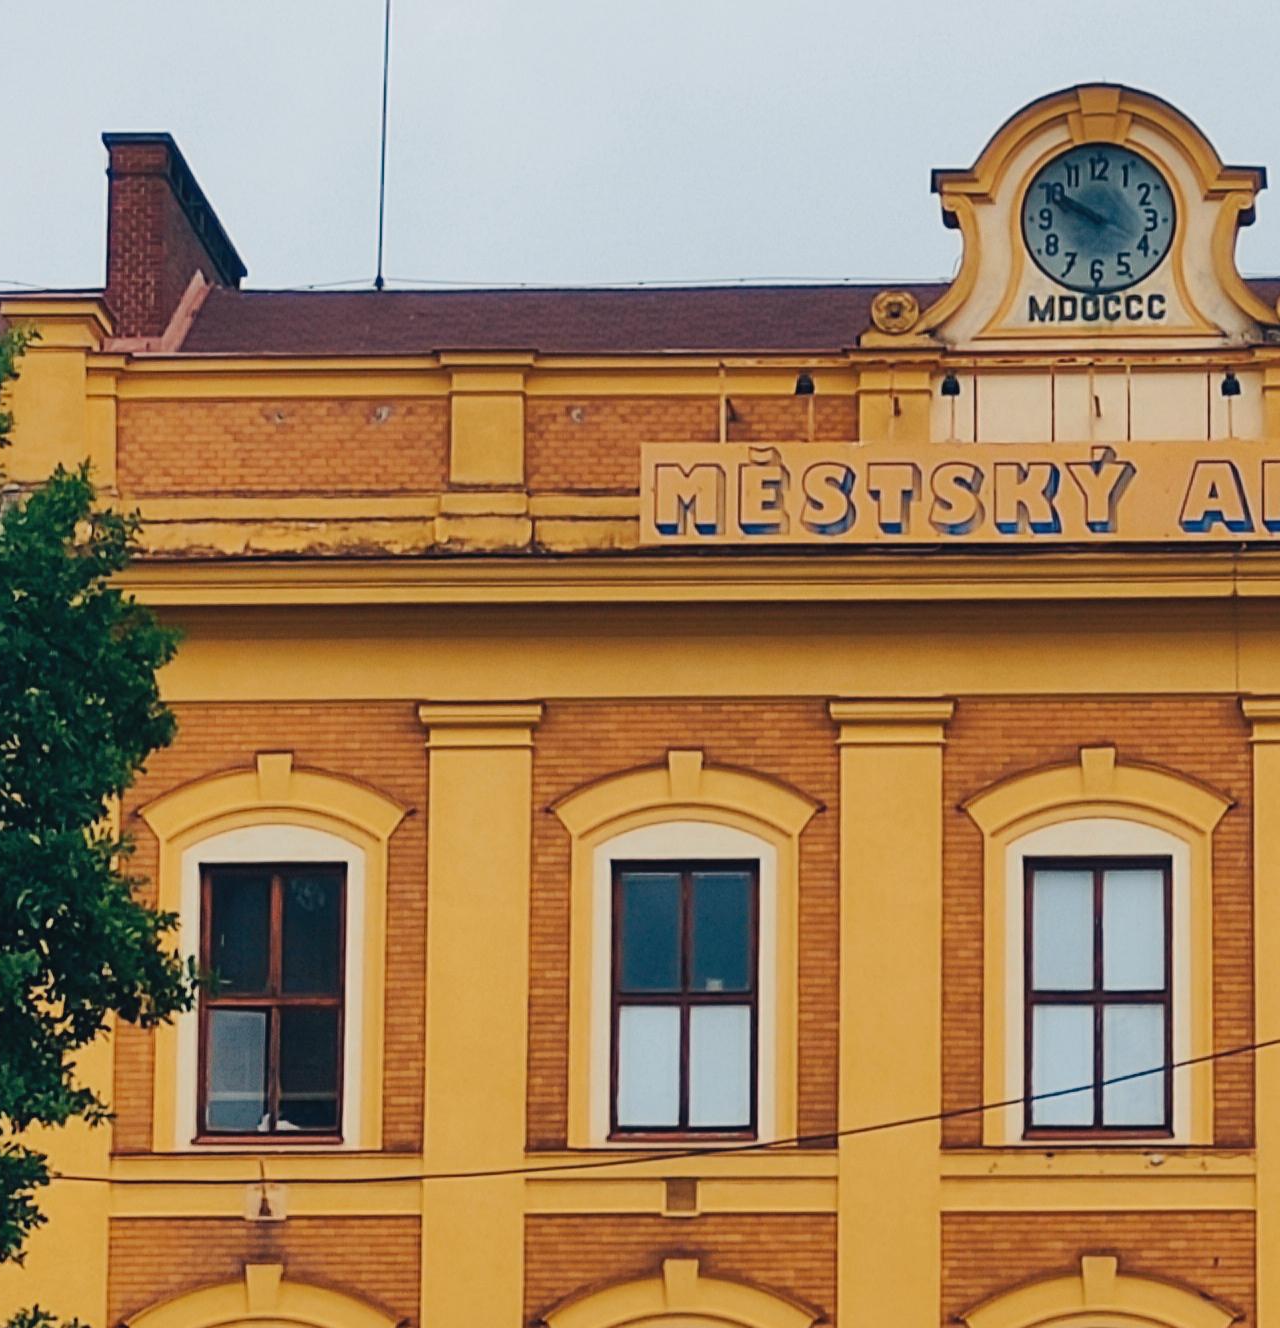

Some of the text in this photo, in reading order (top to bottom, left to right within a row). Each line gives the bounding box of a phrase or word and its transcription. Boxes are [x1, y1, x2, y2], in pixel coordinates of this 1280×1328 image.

[1065, 162, 1080, 188] 11
[1088, 156, 1110, 182] 12
[1121, 163, 1129, 188] 1
[1136, 183, 1152, 206] 2
[1038, 208, 1053, 231] 9
[1144, 208, 1158, 232] 3
[1045, 233, 1059, 257] 8
[1136, 233, 1150, 258] 4
[1063, 252, 1078, 276] 7
[1090, 258, 1105, 282] 6
[1116, 252, 1131, 276] 5
[653, 445, 1137, 536] MĚSTSKÝ
